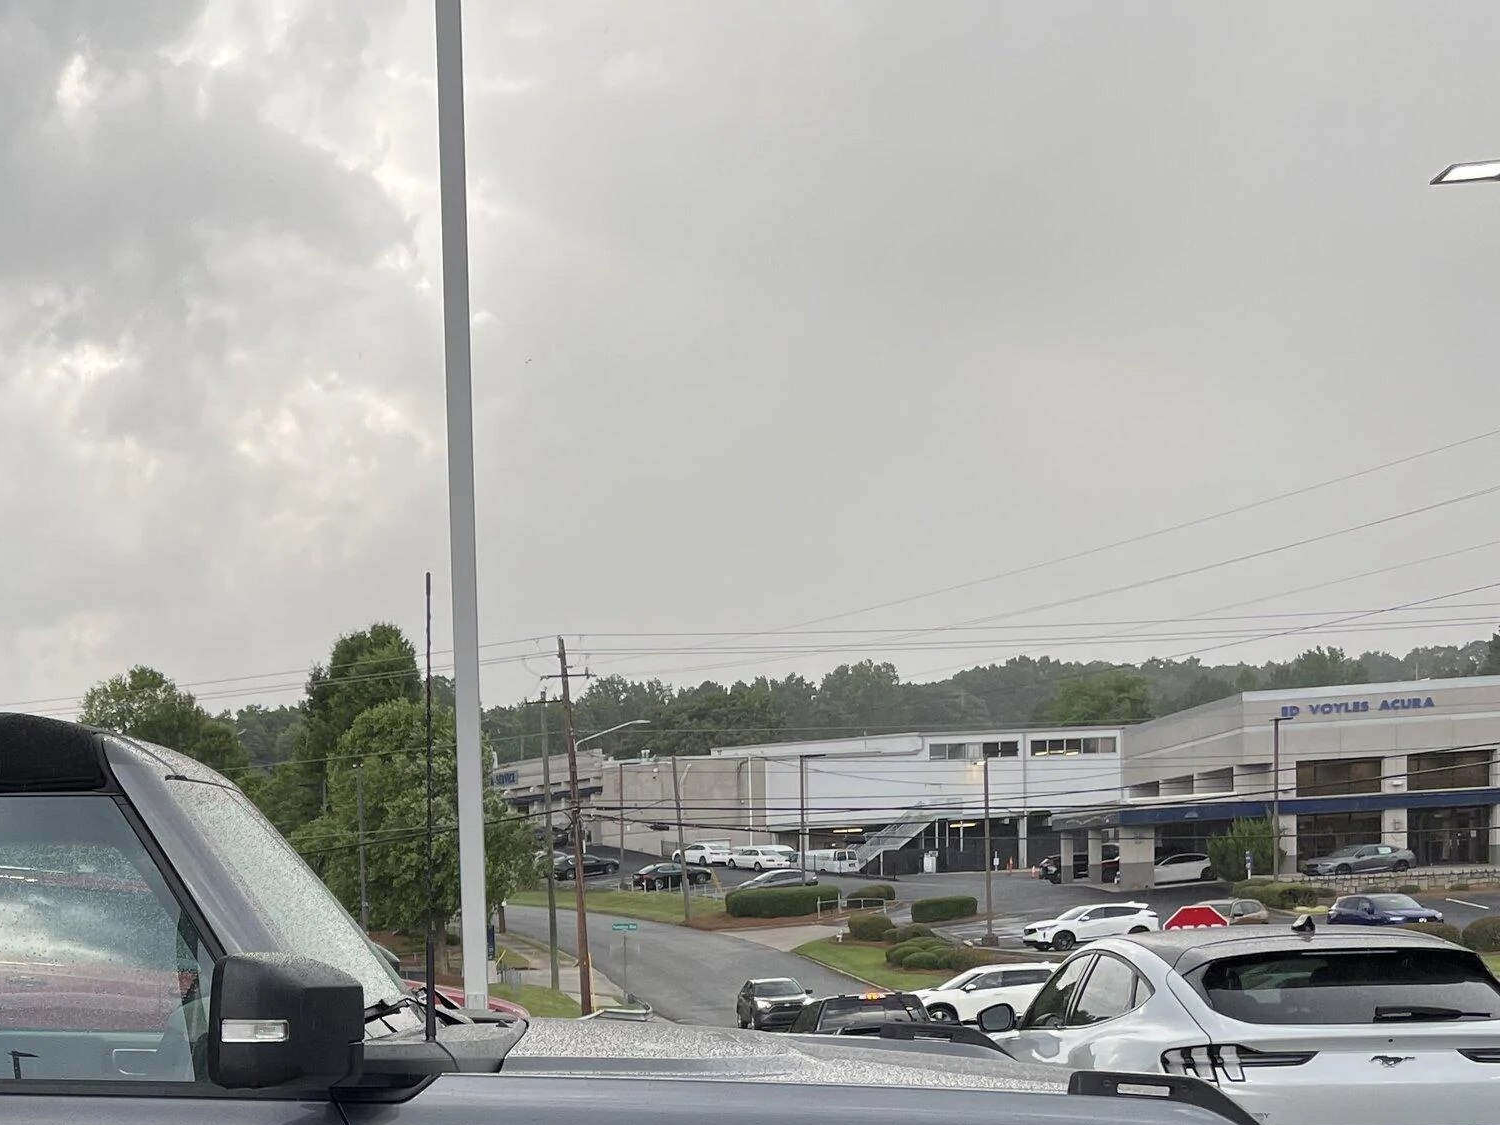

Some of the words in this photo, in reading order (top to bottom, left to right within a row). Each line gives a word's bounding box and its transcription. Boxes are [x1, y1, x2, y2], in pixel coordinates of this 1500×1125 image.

[1281, 706, 1300, 717] ED
[1309, 701, 1369, 715] VOYLES
[1379, 697, 1435, 711] ACURA
